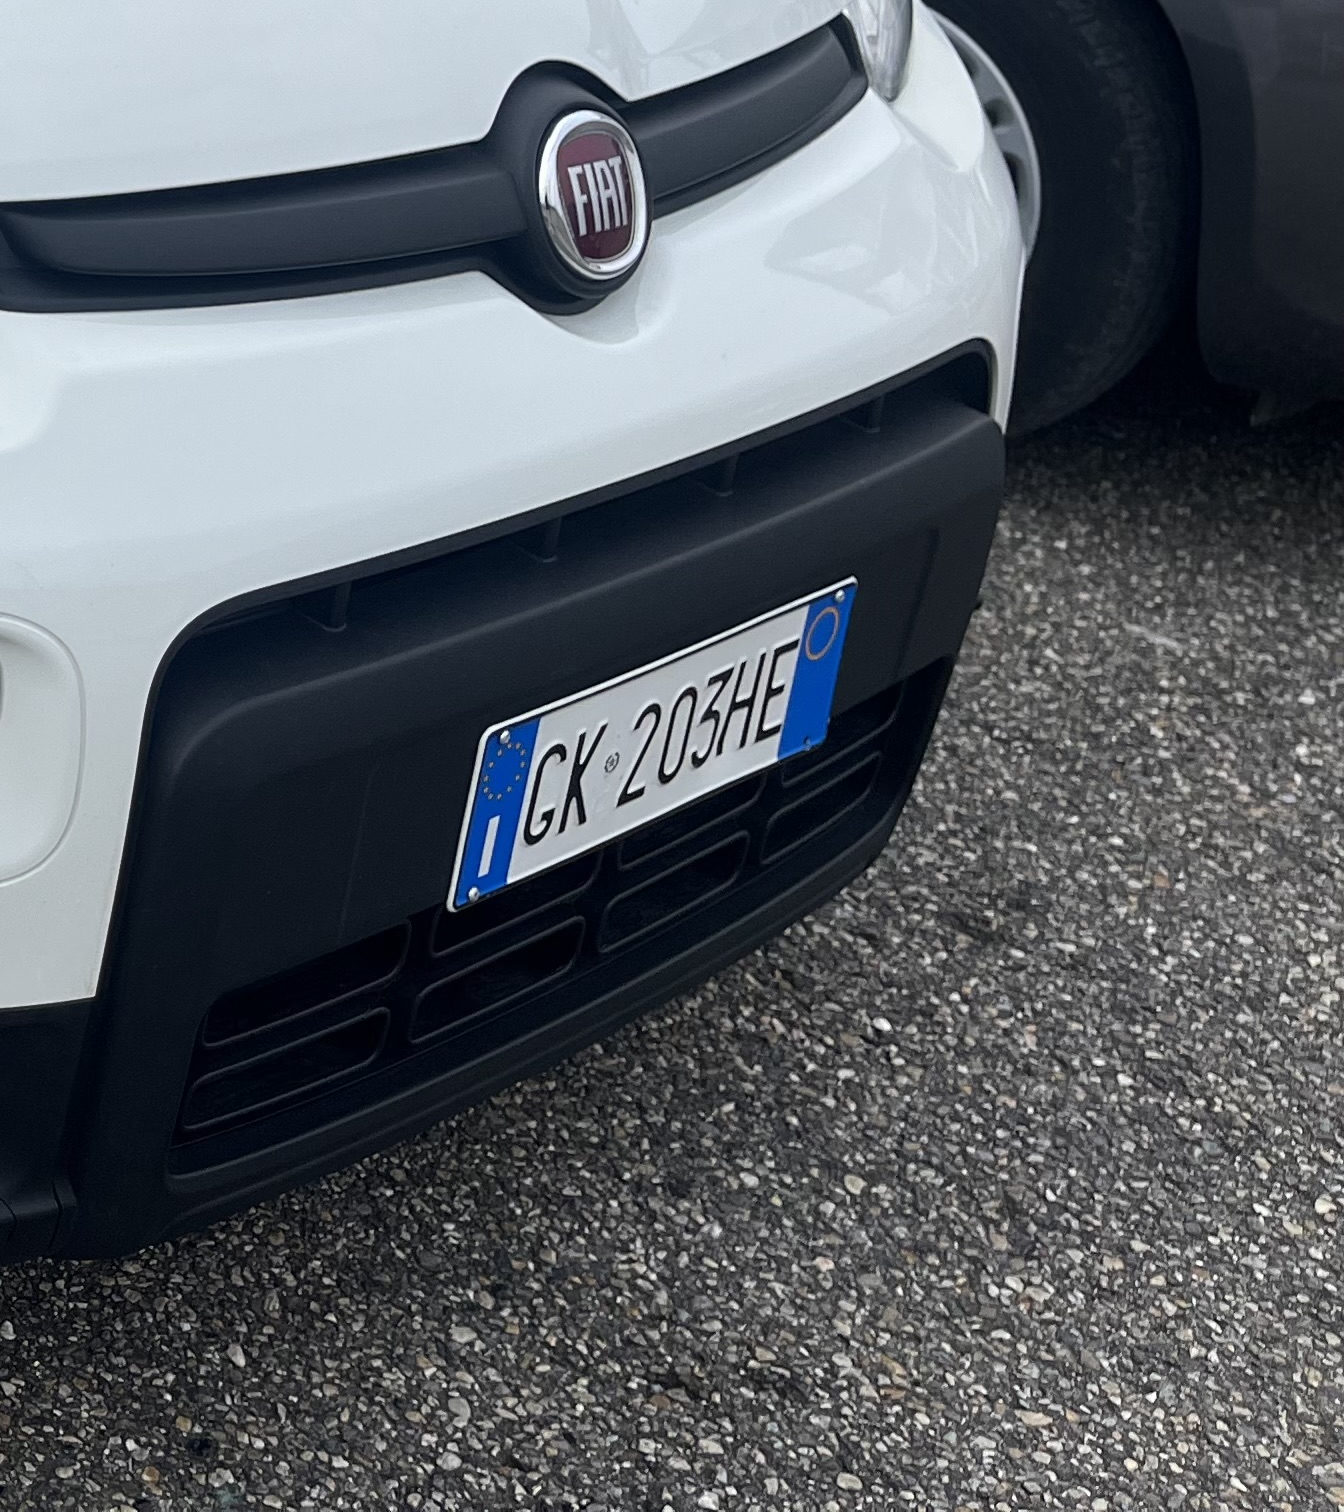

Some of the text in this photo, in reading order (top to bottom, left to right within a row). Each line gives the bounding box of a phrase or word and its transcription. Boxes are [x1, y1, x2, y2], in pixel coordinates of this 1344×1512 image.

[567, 155, 628, 237] FIAT
[523, 638, 800, 847] GK 203HE
